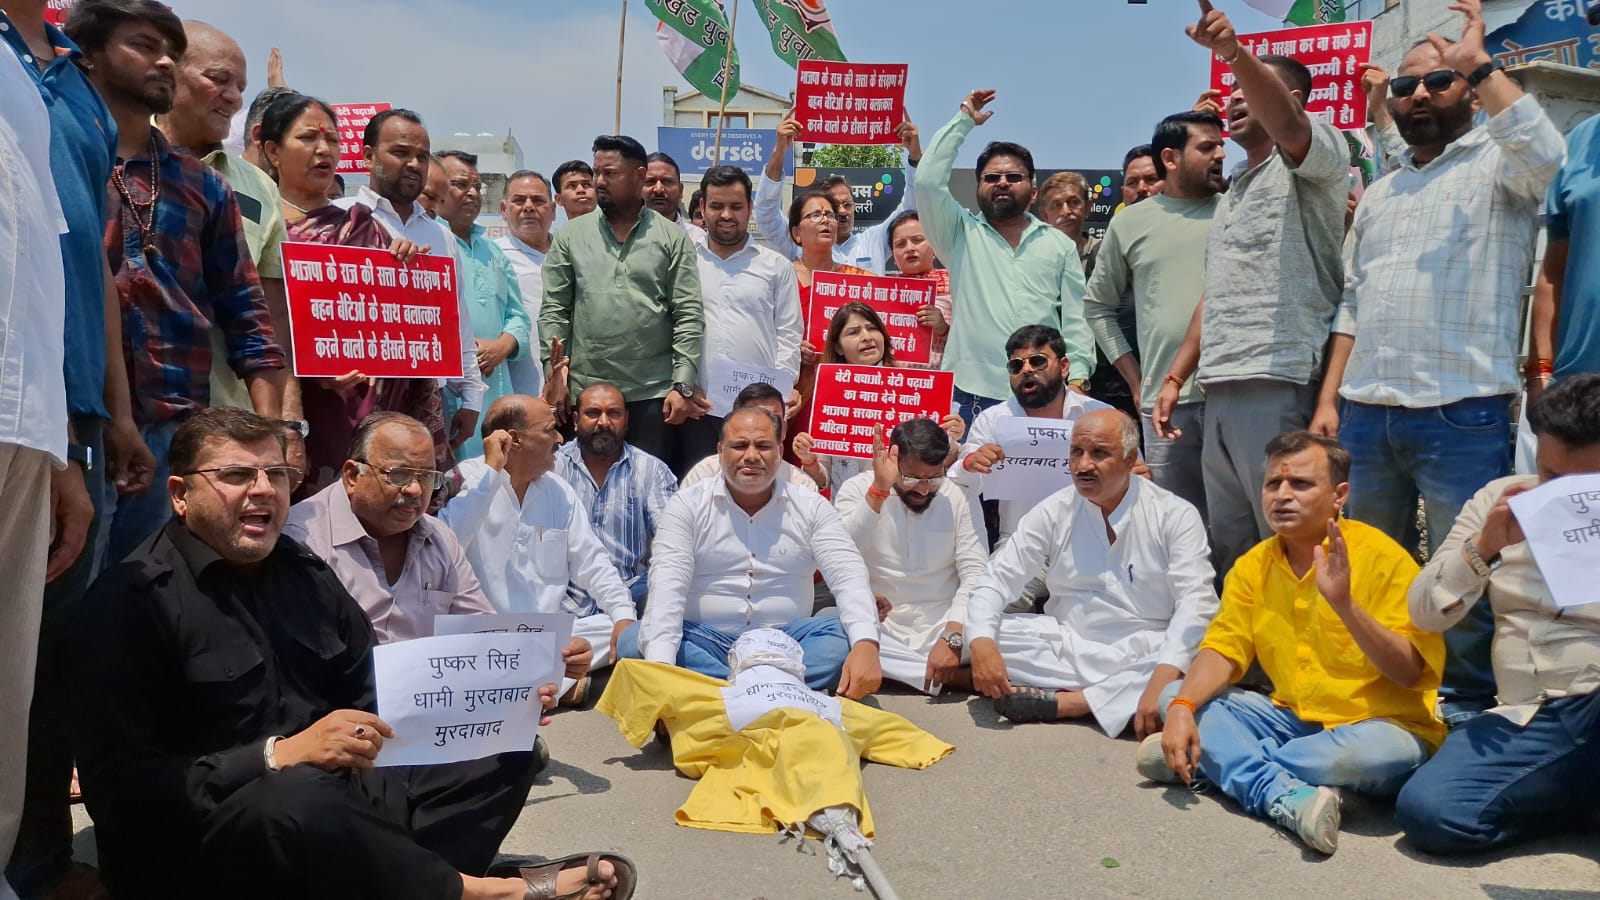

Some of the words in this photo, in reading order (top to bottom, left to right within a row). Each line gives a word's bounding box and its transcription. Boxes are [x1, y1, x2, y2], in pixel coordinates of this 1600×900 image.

[1300, 38, 1314, 53] कर
[1333, 28, 1352, 49] सके
[1354, 27, 1367, 48] जो
[1346, 55, 1356, 75] है
[801, 70, 820, 85] भाजपा
[822, 66, 828, 85] के
[831, 72, 842, 87] राज
[844, 69, 853, 87] की
[870, 70, 876, 87] के
[1343, 80, 1353, 100] है
[808, 96, 823, 110] बहन
[846, 92, 852, 110] के
[855, 98, 867, 111] साथ
[870, 98, 893, 111] बलात्कार
[807, 115, 823, 132] करने
[842, 116, 848, 134] के
[870, 116, 883, 140] बुलंद
[289, 260, 323, 282] भाजपा
[325, 254, 337, 282] के
[340, 263, 358, 284] राज
[360, 258, 374, 286] की
[377, 265, 396, 287] सत्ता
[398, 263, 408, 288] के
[411, 263, 440, 293] संरक्षण
[443, 265, 451, 291] में
[816, 281, 837, 296] भाजपा
[839, 279, 847, 297] के
[848, 285, 860, 299] राज
[862, 282, 872, 300] की
[875, 287, 888, 301] सत्ता
[890, 283, 898, 302] के
[900, 285, 922, 305] संरक्षण
[310, 299, 334, 321] बहन
[368, 294, 378, 322] के
[381, 303, 401, 324] साथ
[403, 304, 441, 325] बलात्कार
[314, 329, 339, 359] करने
[342, 330, 364, 359] वालो
[367, 331, 377, 359] के
[380, 331, 406, 361] हौसले
[408, 334, 430, 369] बुलंद
[733, 370, 755, 382] पुष्कर
[835, 369, 851, 383] बेटी
[854, 372, 884, 386] बचाओ,
[887, 372, 903, 387] बेटी
[844, 390, 856, 400] का
[859, 391, 878, 402] नारा
[881, 390, 896, 404] देने
[899, 392, 920, 406] वाली
[822, 405, 850, 417] भाजपा
[853, 408, 882, 420] सरकार
[886, 408, 896, 420] के
[820, 420, 848, 434] महिला
[1027, 427, 1068, 446] पुष्कर
[428, 655, 477, 679] पुष्कर
[487, 648, 520, 671] सिहं
[414, 685, 454, 710] धामी
[464, 686, 533, 712] मुरदाबाद
[434, 720, 504, 747] मुरदाबाद
